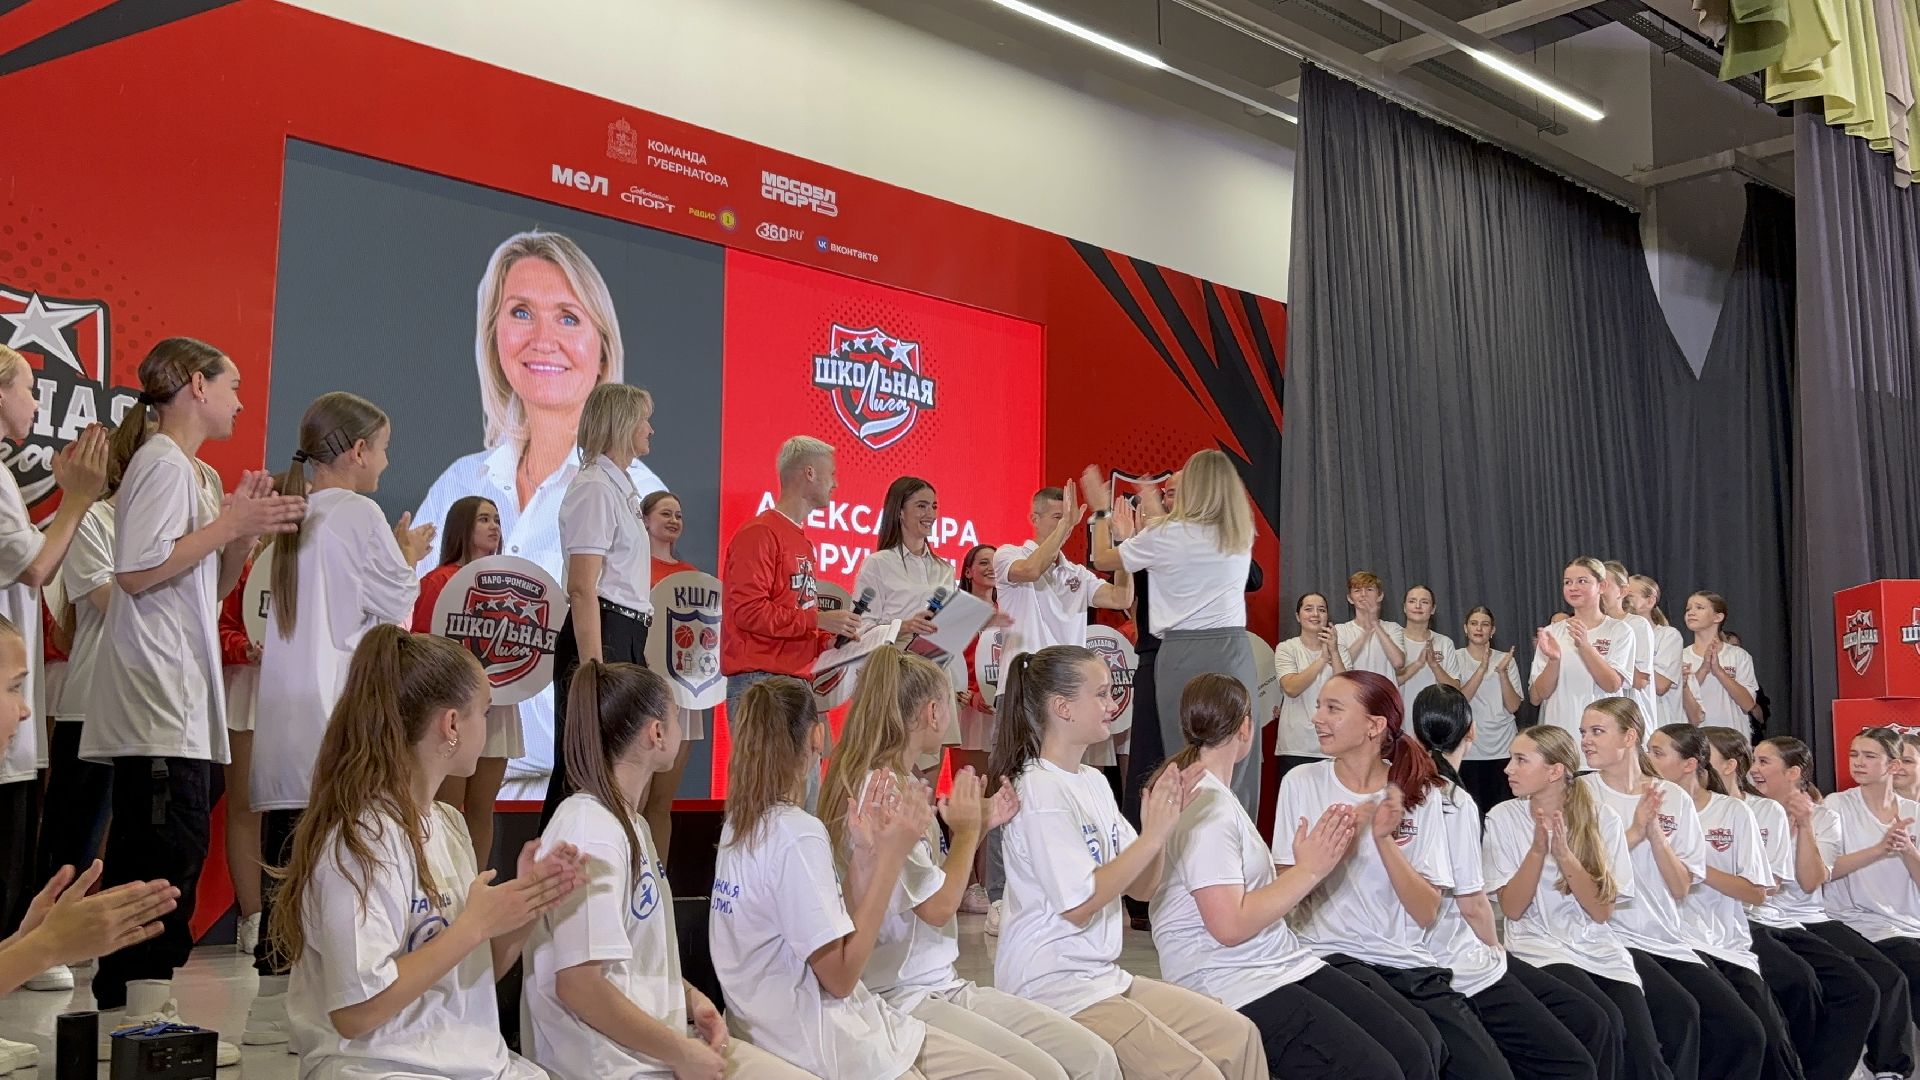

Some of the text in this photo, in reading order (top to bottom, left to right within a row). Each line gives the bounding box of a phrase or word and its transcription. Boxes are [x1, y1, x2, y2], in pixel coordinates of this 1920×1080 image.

[647, 139, 707, 165] КОМАНДА
[647, 155, 729, 187] ГУБЕРНАТОРА
[761, 170, 836, 203] МОСОБЛ
[761, 184, 820, 212] СПОРТ
[620, 191, 676, 213] СПОРТ
[815, 356, 935, 407] ШКОЛЬНАЯ
[481, 575, 541, 595] НАРО-ФОМИНСК
[674, 585, 719, 613] КШЛ
[447, 614, 558, 651] ШКОЛЬНАЯ
